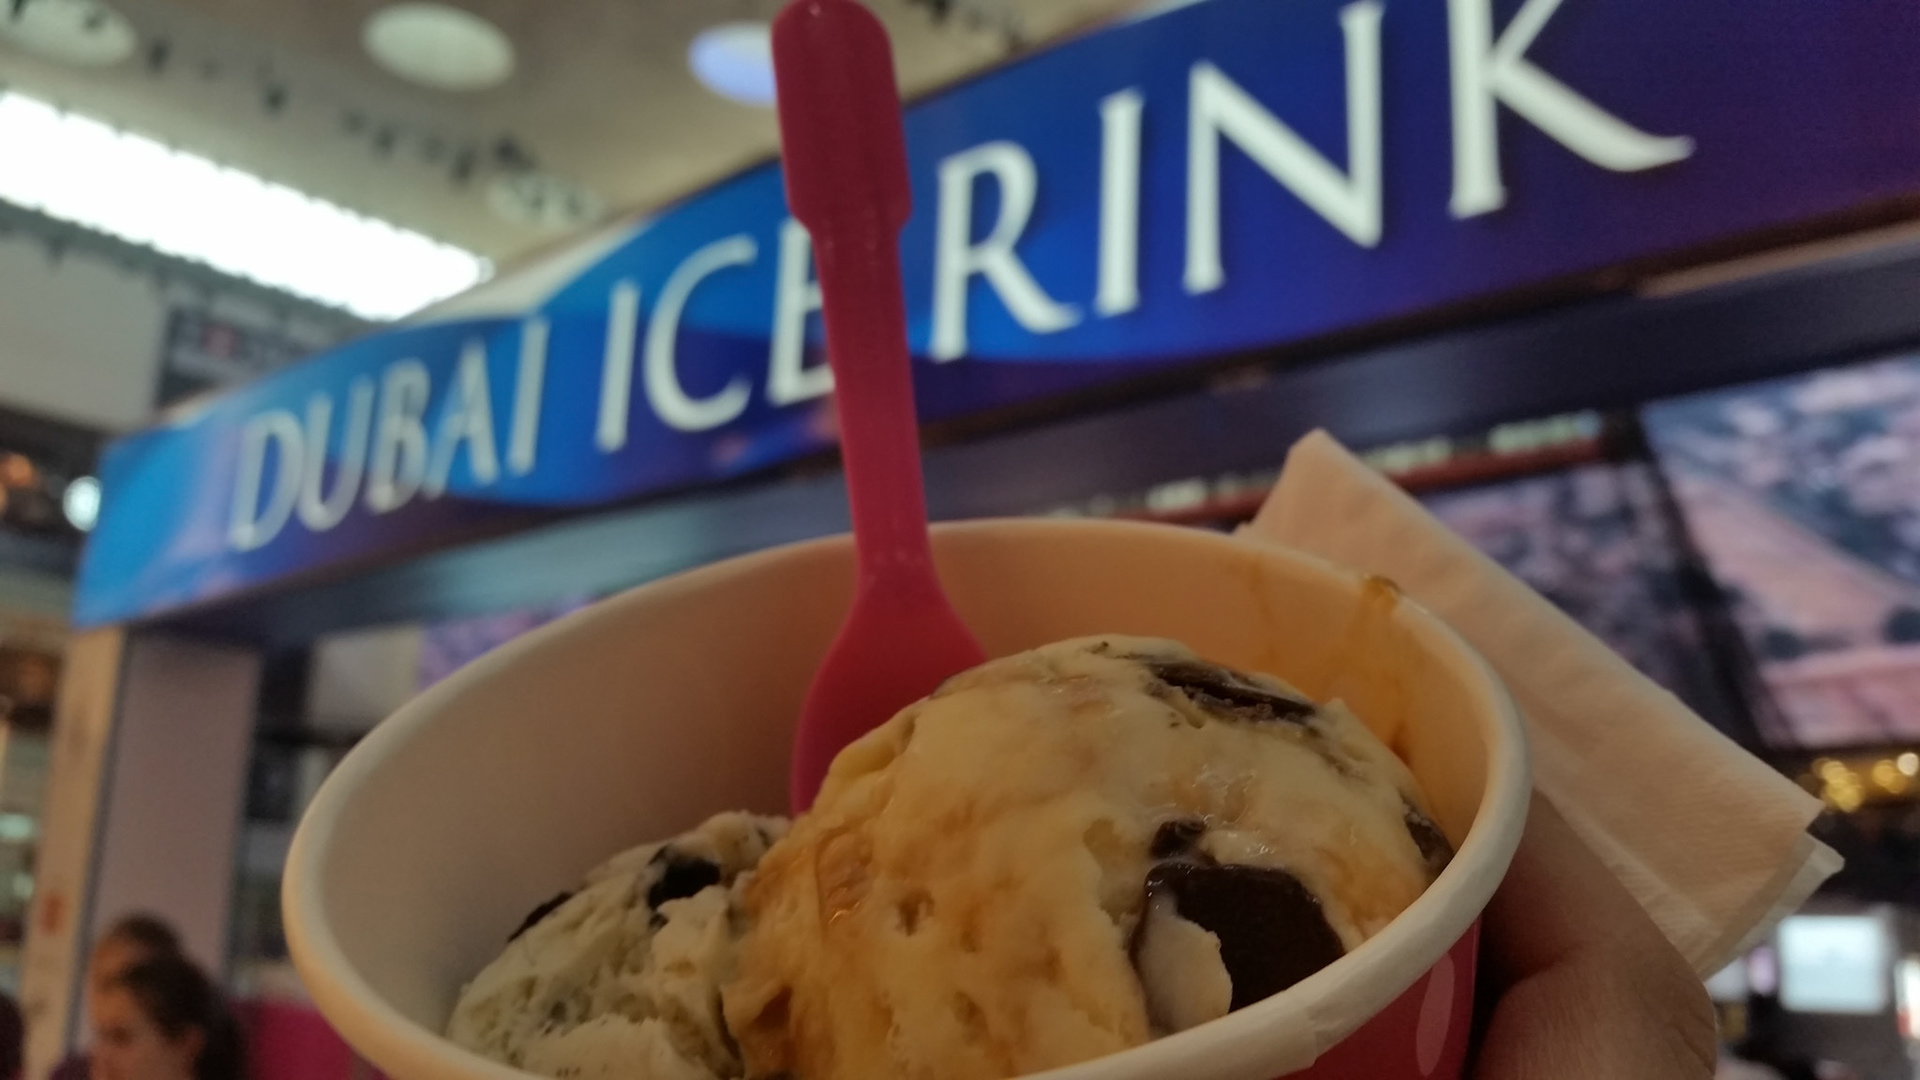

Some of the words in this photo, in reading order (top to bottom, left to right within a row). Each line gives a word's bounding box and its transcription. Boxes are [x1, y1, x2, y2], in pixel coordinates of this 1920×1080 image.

[229, 316, 549, 551] DUBAI
[596, 219, 836, 452] ICE
[930, 0, 1695, 361] RINK
